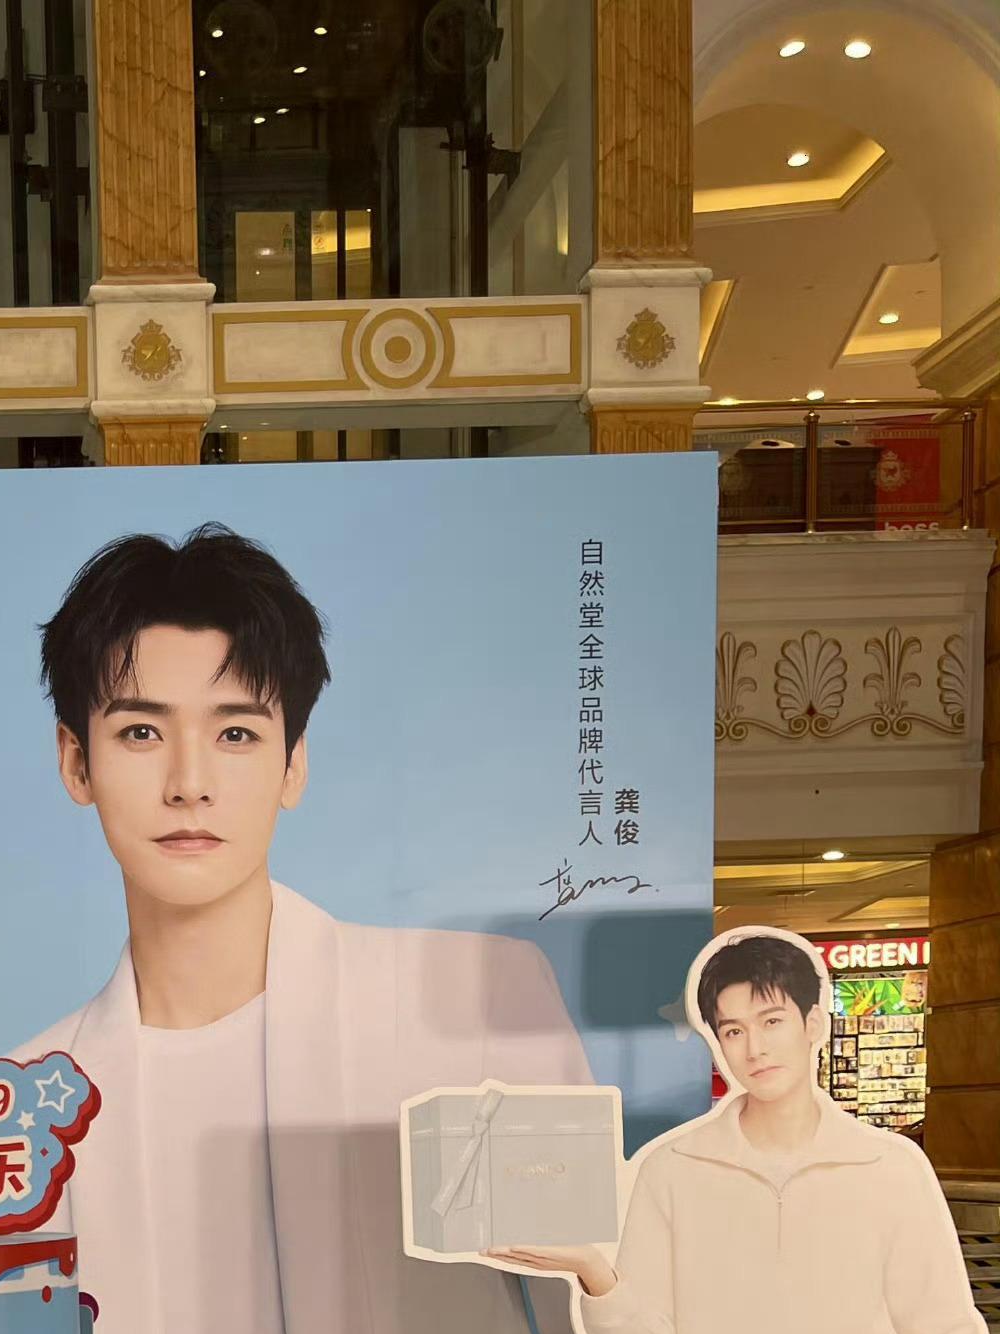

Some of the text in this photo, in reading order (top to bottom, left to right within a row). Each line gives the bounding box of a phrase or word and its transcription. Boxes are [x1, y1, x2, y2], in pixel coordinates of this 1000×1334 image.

[578, 538, 605, 847] 自然堂全球品牌代言人
[614, 787, 640, 847] 龚俊
[828, 942, 918, 969] GREEN
